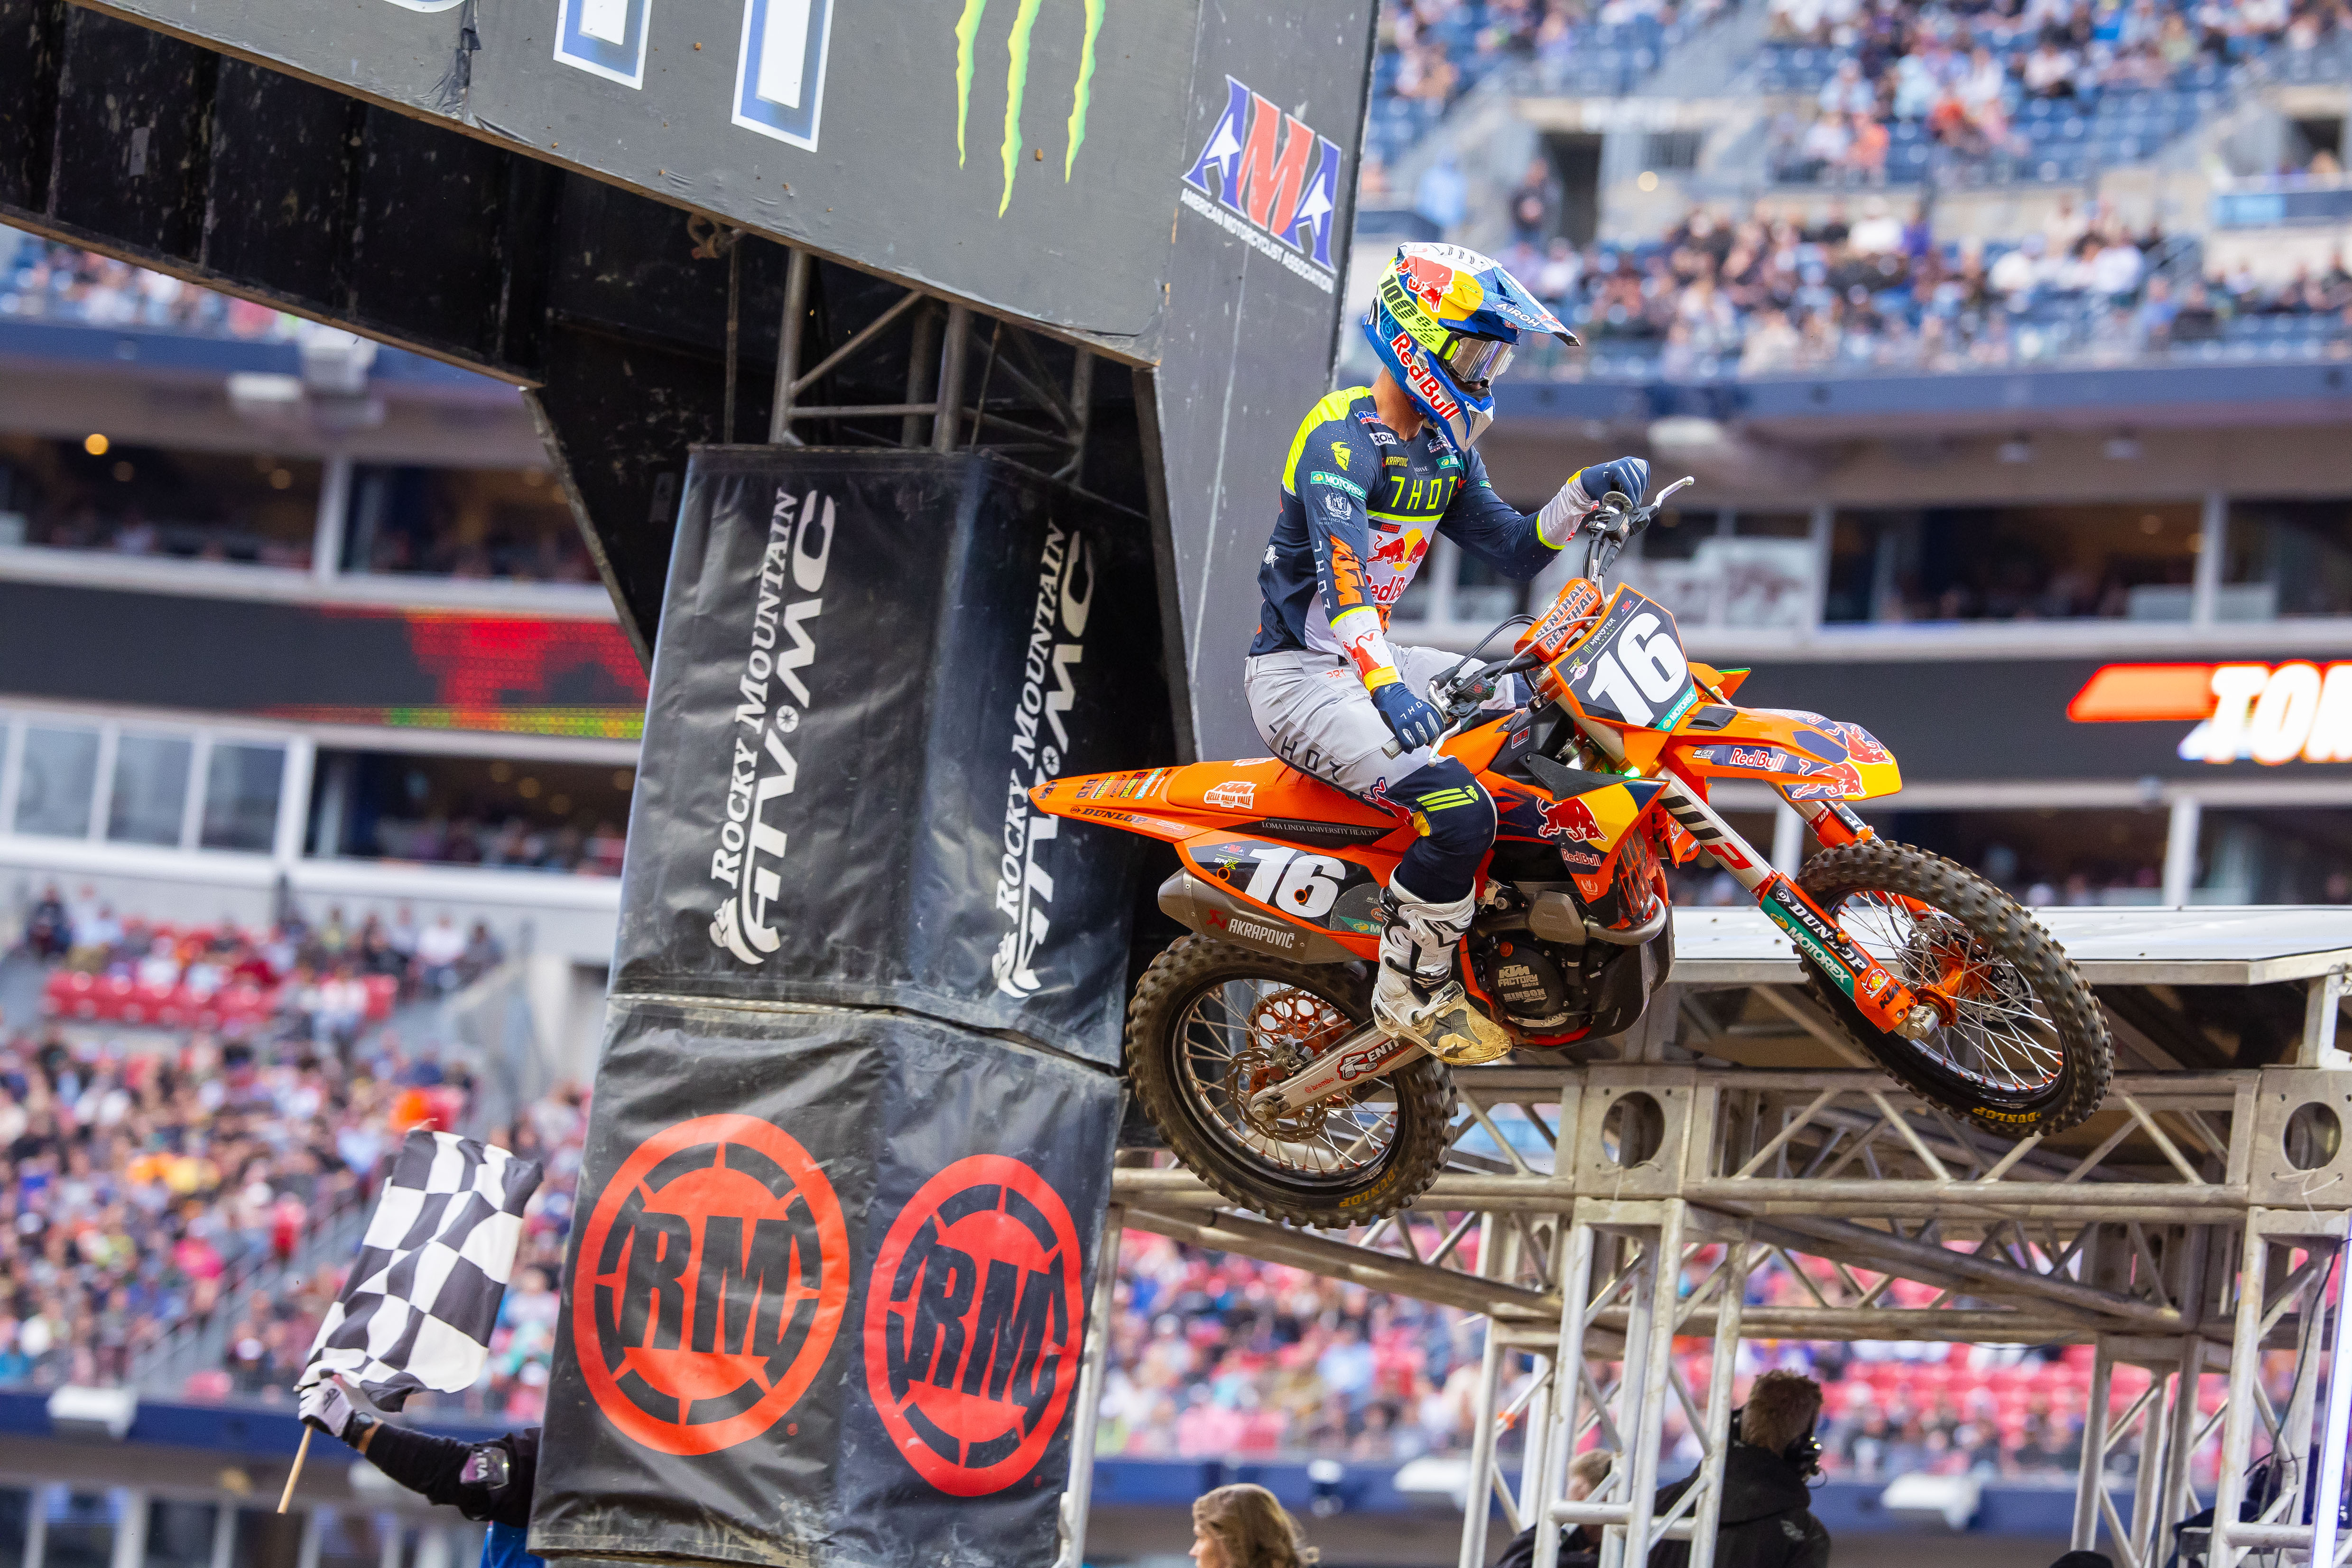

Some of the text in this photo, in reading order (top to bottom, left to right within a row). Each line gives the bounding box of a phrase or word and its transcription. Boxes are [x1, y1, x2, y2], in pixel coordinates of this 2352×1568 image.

[1180, 74, 1342, 274] AMA
[1380, 274, 1444, 344] 100%
[1495, 303, 1541, 327] AIROH
[1391, 332, 1460, 420] Red Bull
[1324, 474, 1363, 497] MOTOREX
[1330, 534, 1365, 607] KTM
[1535, 584, 1587, 639] RENTHAL
[1545, 592, 1596, 651] RENTHAL
[1590, 617, 1616, 646] MONSTER
[1587, 612, 1687, 727] 16
[710, 486, 798, 889] ROCKY MOUNTAIN
[1668, 690, 1695, 722] MOTOREX
[996, 517, 1067, 924] ROCKY MOUNTAIN
[1730, 748, 1787, 771] Red Bull
[1094, 775, 1116, 798] HINSON
[1135, 773, 1157, 798] MOTOREX
[1214, 783, 1253, 794] KTM
[1206, 791, 1252, 806] SELLE DALLA VALLE
[1081, 807, 1148, 824] DUNLOP
[1156, 820, 1185, 831] 250
[1261, 821, 1283, 830] LOMA
[1284, 824, 1306, 832] LINDA
[1306, 826, 1348, 835] UNIVERSITY
[1213, 857, 1240, 870] SMX
[1561, 848, 1602, 867] Red Bull
[1245, 846, 1346, 918] 16
[1788, 902, 1867, 969] DUNLOP
[1787, 926, 1850, 984] MOTOREX
[1498, 974, 1538, 987] FACTORY
[1499, 965, 1530, 979] KTM
[1502, 988, 1546, 1001] HINSON
[1879, 982, 1901, 1010] KTM
[1311, 1076, 1335, 1091] brembo
[1972, 1106, 2037, 1123] DUNLOP
[1338, 1168, 1396, 1208] DUNLOP
